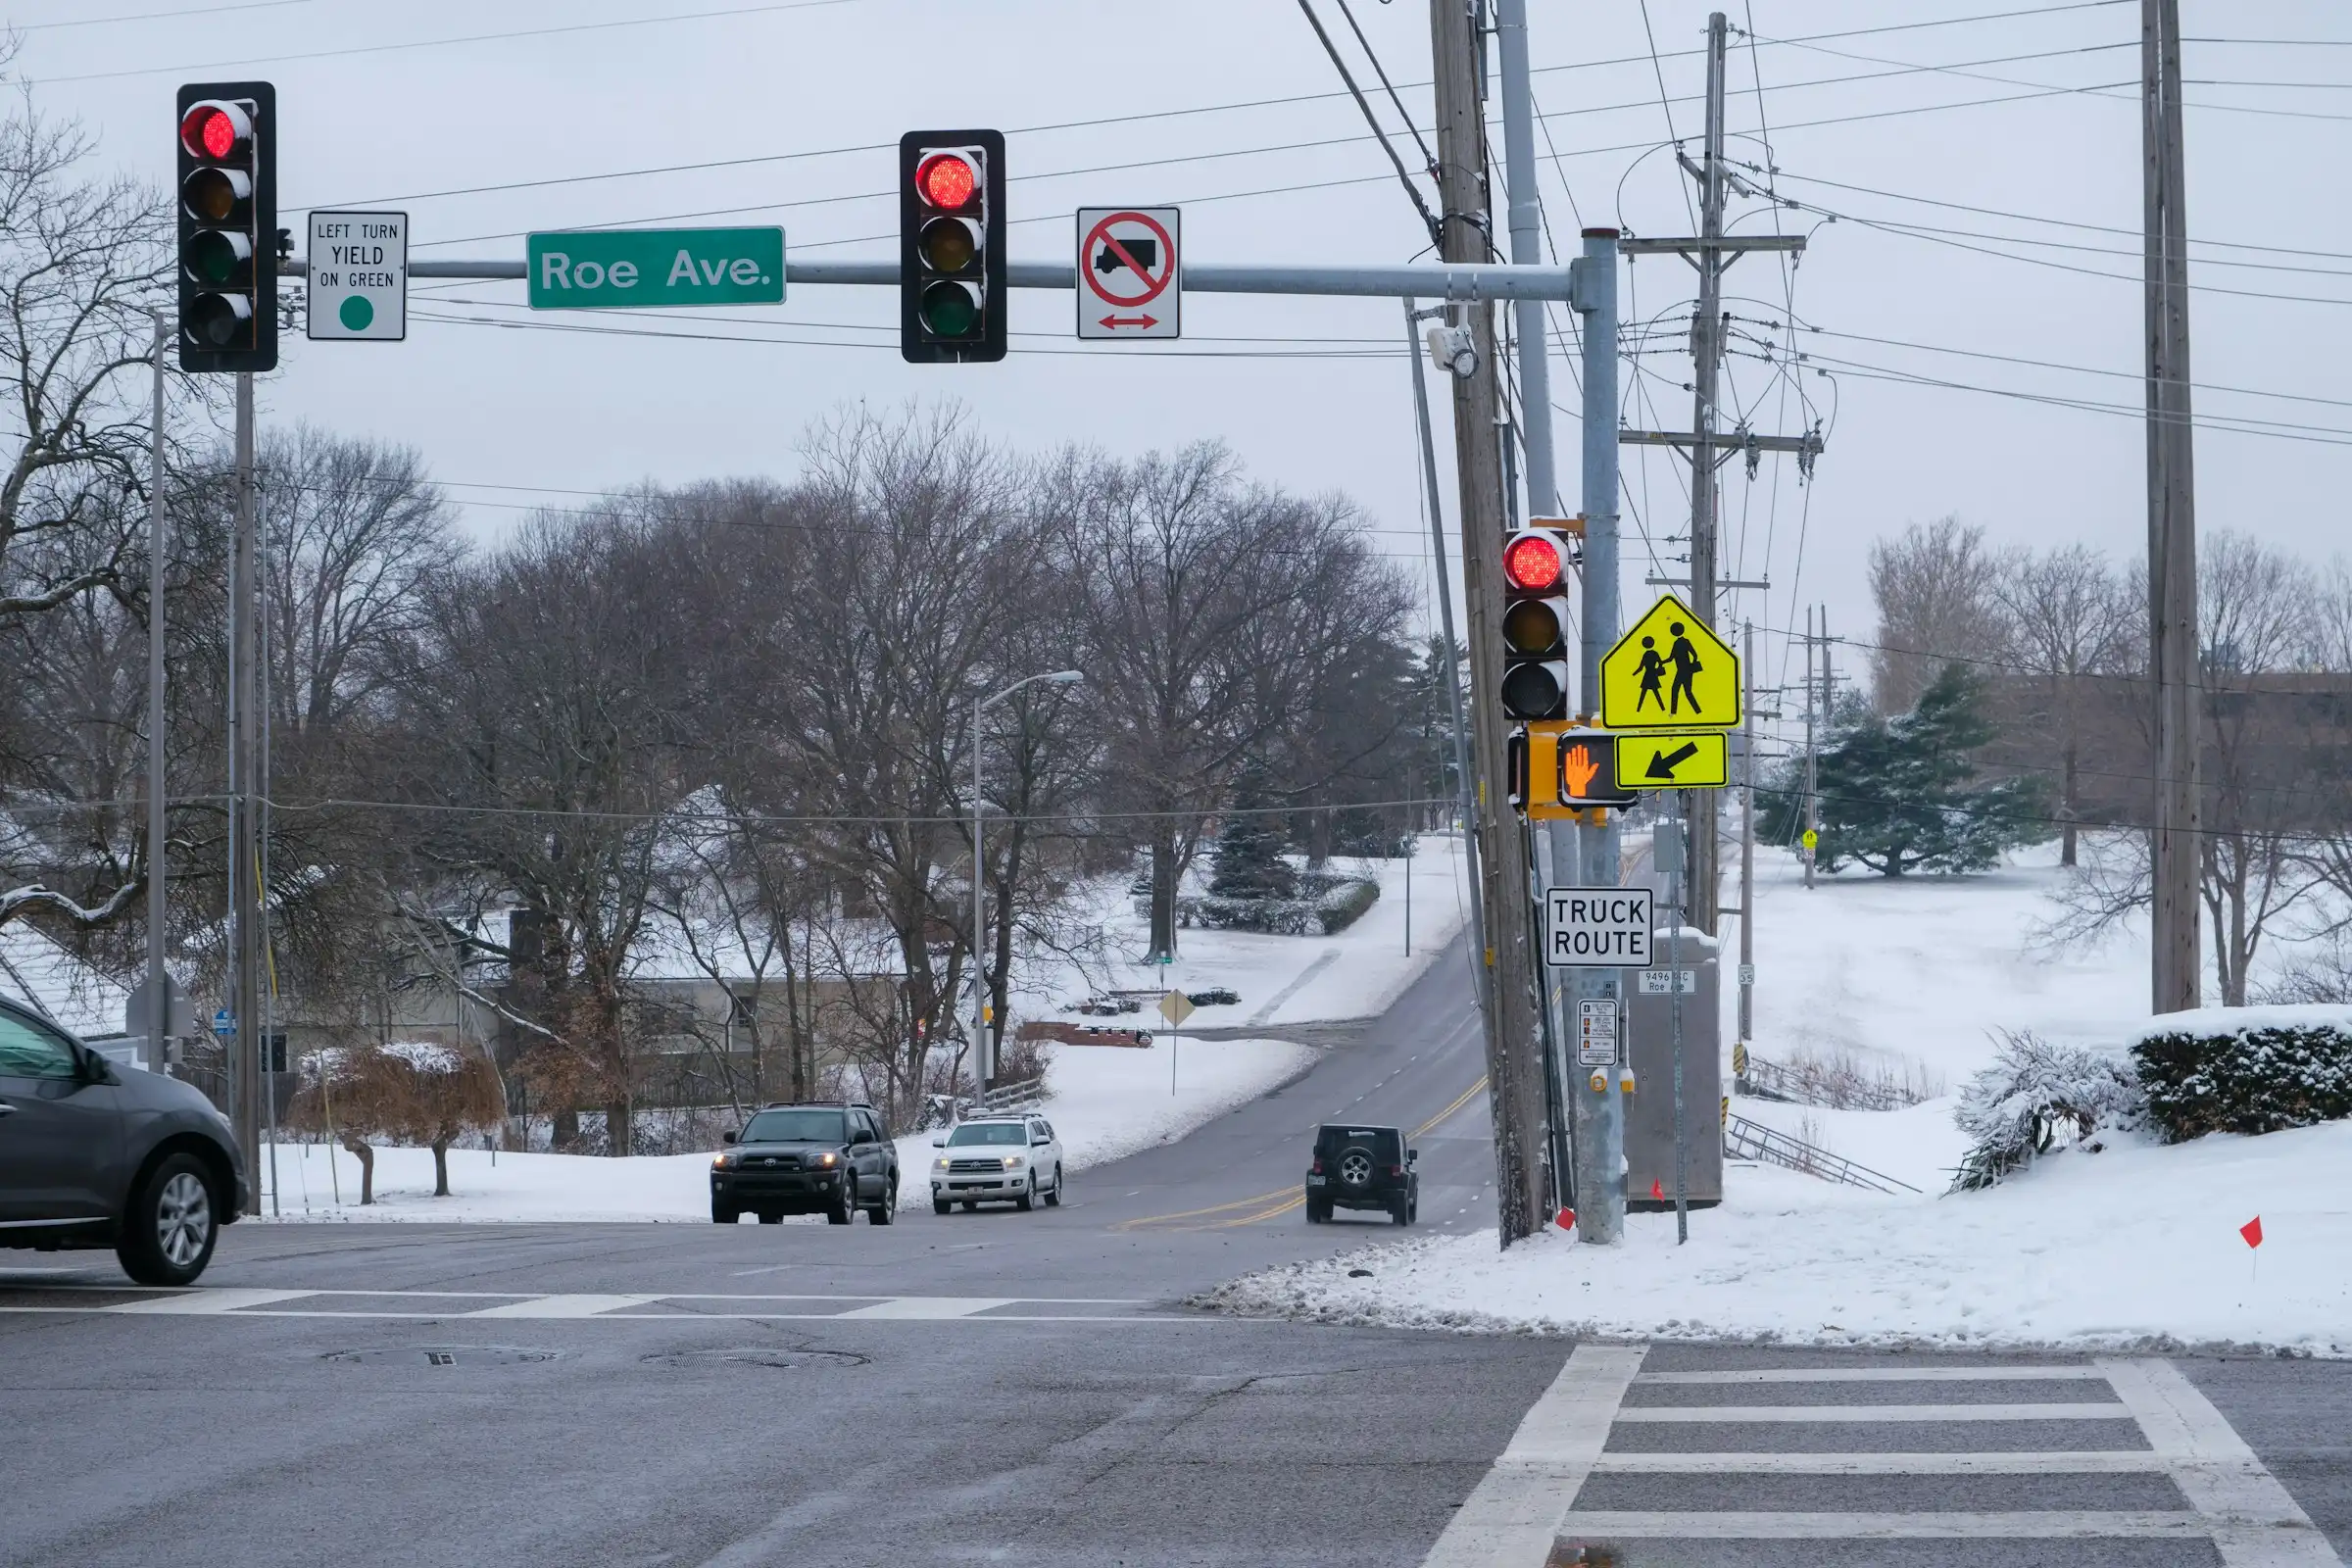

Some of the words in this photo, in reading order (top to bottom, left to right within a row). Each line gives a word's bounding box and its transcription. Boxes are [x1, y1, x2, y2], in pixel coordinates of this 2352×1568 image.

[318, 223, 351, 238] LEFT
[362, 224, 398, 238] TURN
[331, 246, 384, 265] YIELD
[542, 253, 637, 289] Roe
[666, 250, 770, 285] Ave.
[320, 272, 339, 287] ON
[349, 272, 394, 287] GREEN
[1554, 899, 1645, 924] TRUCK
[1555, 930, 1644, 956] ROUTE
[1645, 972, 1670, 981] 9496
[1740, 974, 1753, 983] 35
[1649, 982, 1665, 992] Roe
